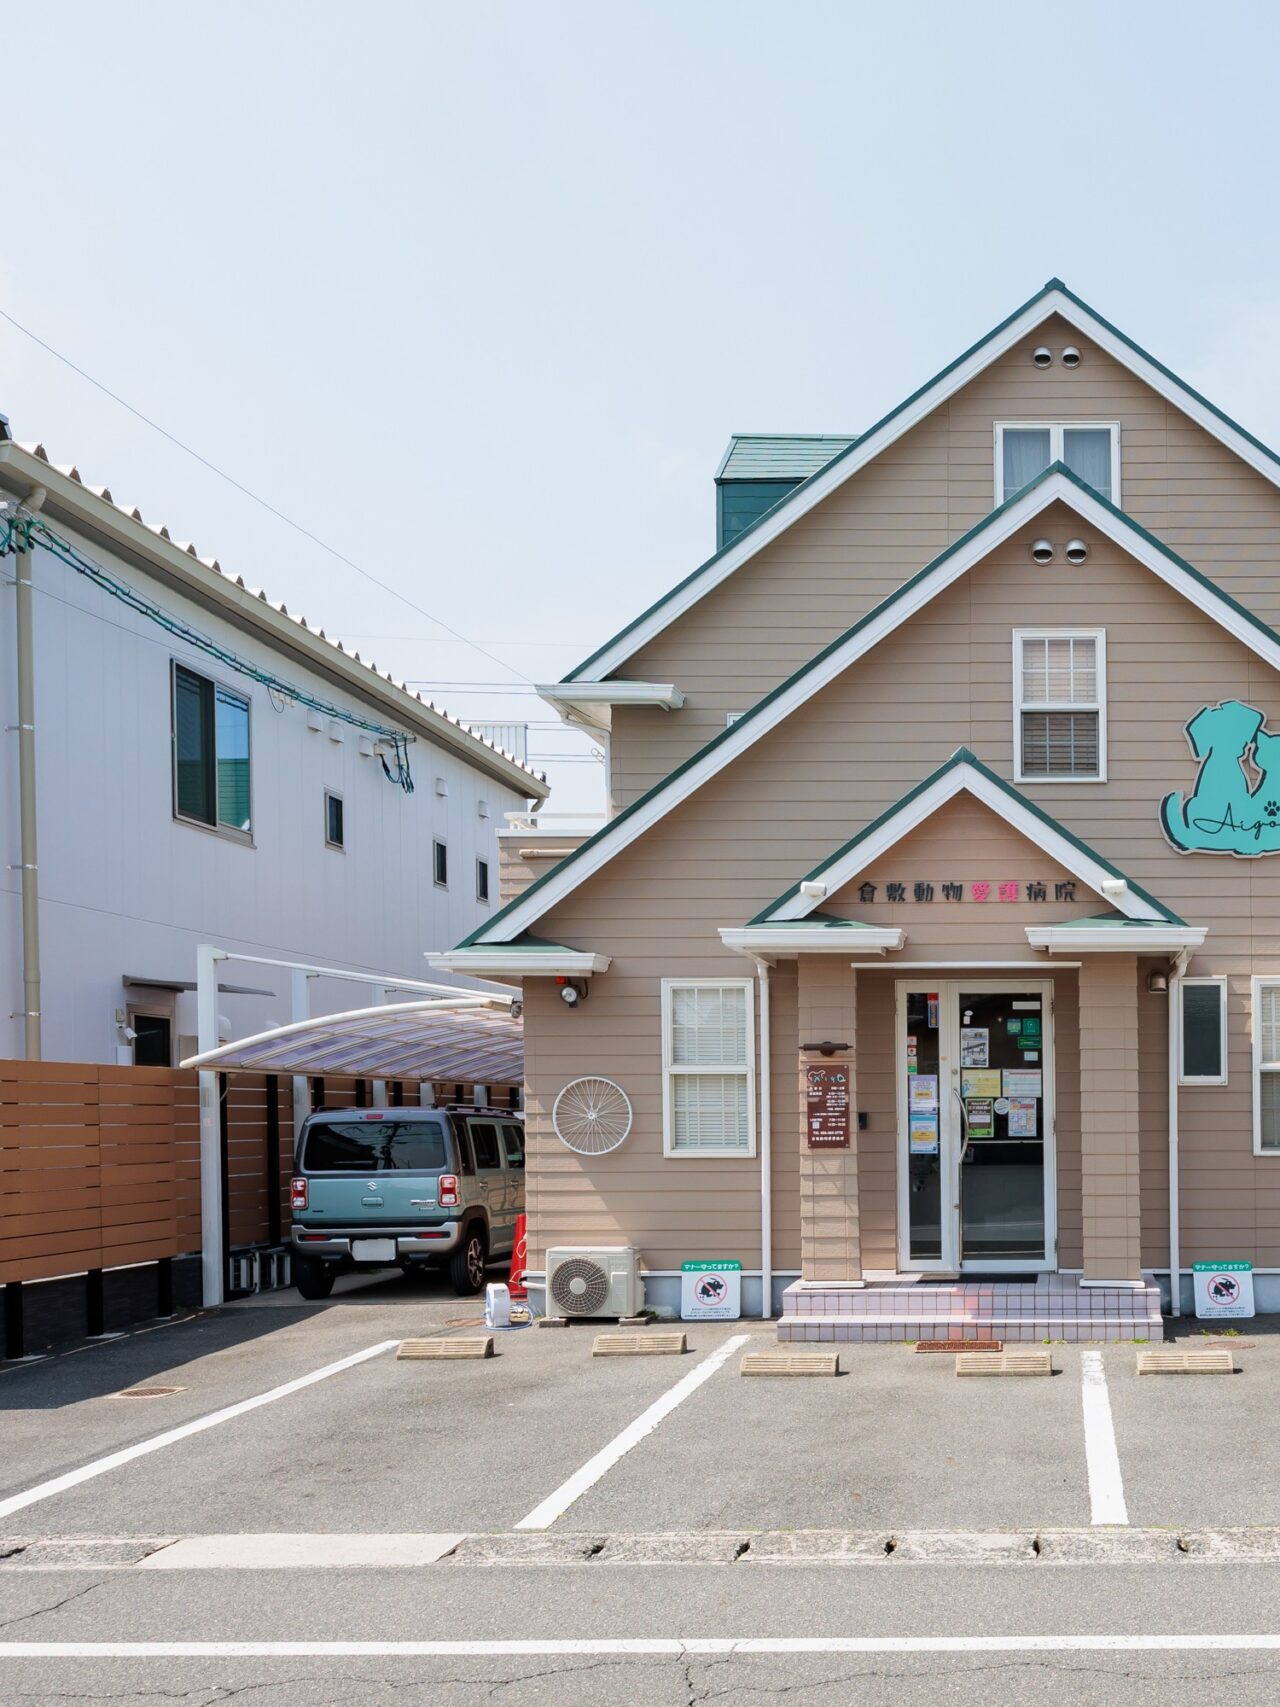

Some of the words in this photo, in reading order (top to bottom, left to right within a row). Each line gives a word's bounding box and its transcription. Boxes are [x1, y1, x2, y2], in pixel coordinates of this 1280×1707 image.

[858, 880, 1076, 903] 倉敷動物愛護病院
